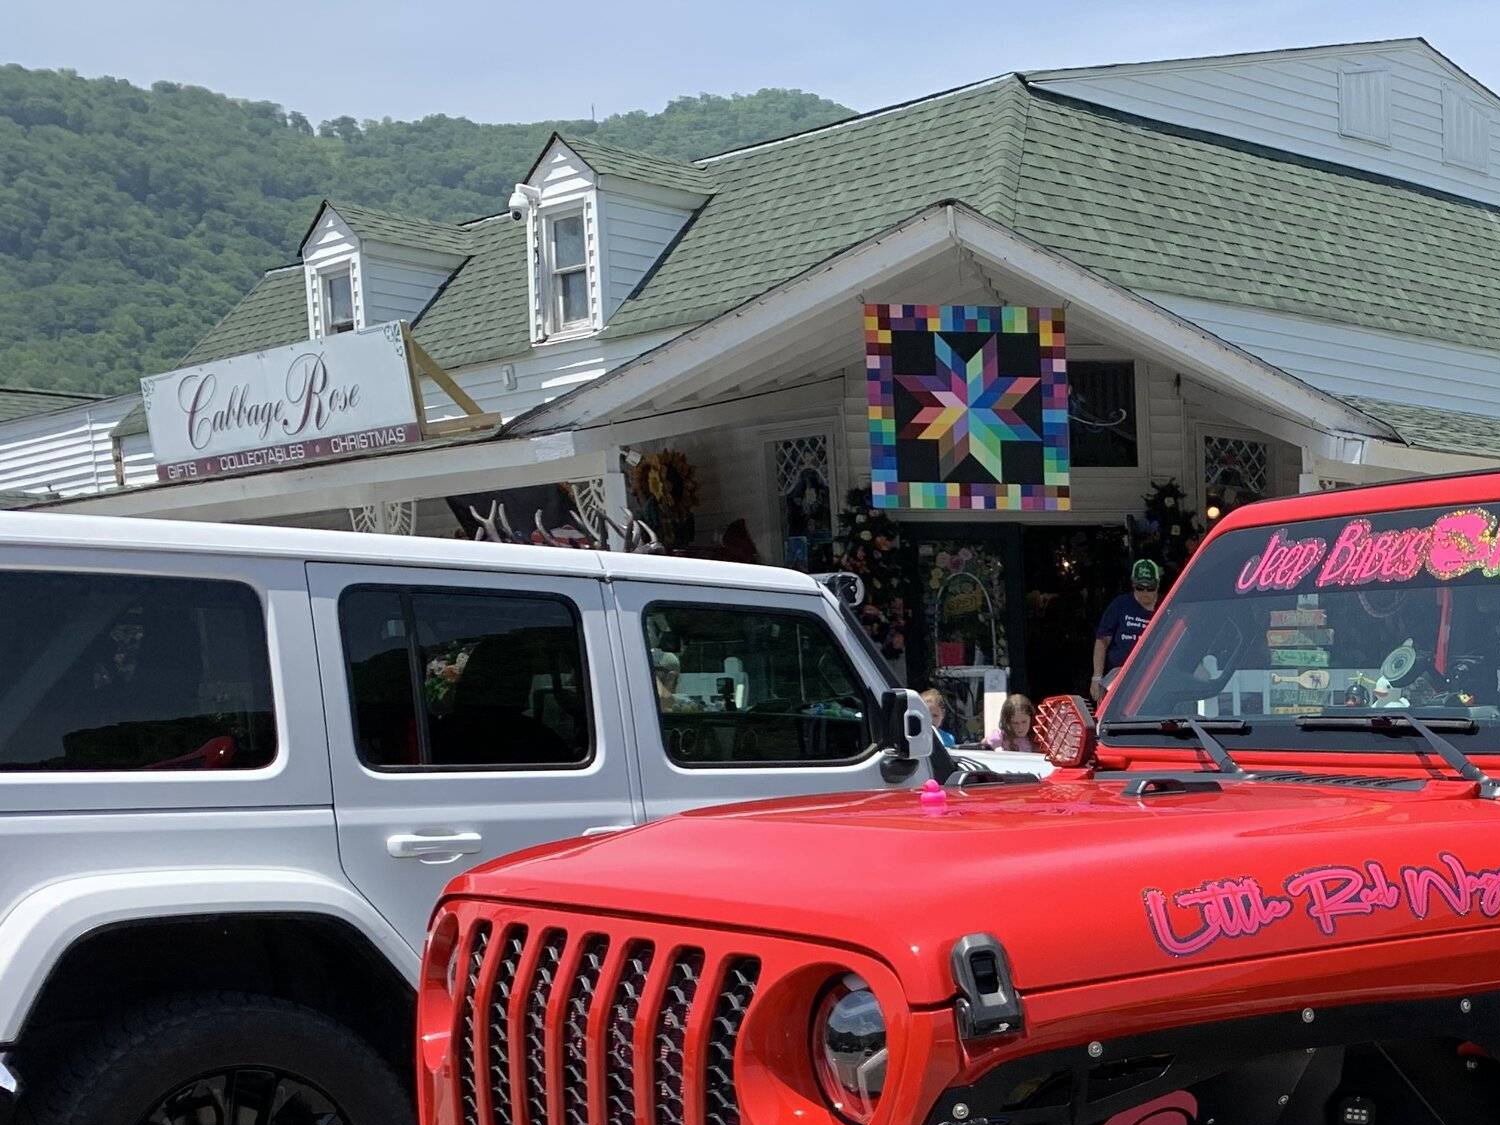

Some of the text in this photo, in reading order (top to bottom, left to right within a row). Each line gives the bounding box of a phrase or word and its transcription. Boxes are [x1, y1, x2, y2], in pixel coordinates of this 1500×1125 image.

[177, 352, 360, 450] Cabbage Rose
[167, 427, 406, 480] GIFTS COLLECTABLES CHRISTMAS
[1143, 876, 1293, 957] Little
[1284, 858, 1400, 936] Red
